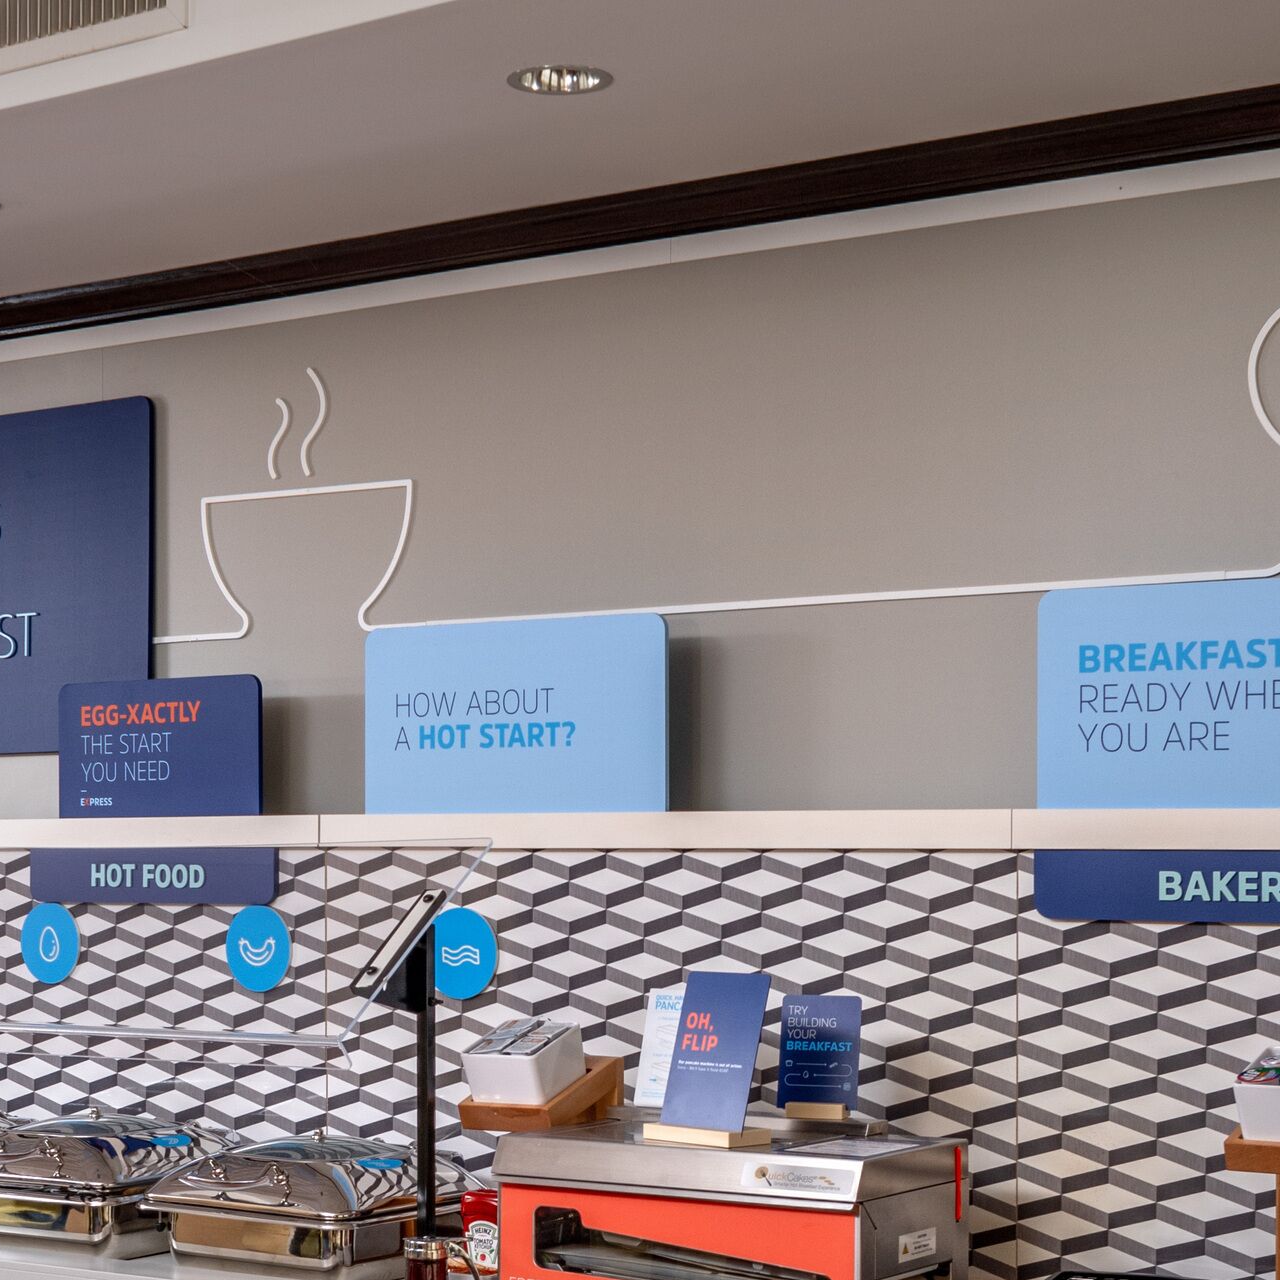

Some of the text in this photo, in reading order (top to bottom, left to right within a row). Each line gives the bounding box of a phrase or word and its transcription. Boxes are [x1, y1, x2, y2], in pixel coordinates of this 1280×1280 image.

[395, 687, 555, 718] HOW ABOUT
[1079, 681, 1191, 713] READY
[80, 700, 201, 727] EGG-XACTLY
[80, 732, 172, 755] THE START
[395, 721, 576, 751] A HOT START?
[1078, 720, 1230, 752] YOU ARE
[81, 760, 170, 782] YOU NEED
[80, 797, 113, 806] EXPRESS
[90, 863, 206, 889] HOT FOOD
[788, 1005, 809, 1015] TRY
[686, 1011, 714, 1032] OH,
[787, 1017, 837, 1028] BUILDING
[681, 1033, 719, 1052] FLIP
[787, 1029, 817, 1040] YOUR
[786, 1041, 853, 1052] BREAKFAST
[474, 1227, 492, 1236] HEINZ
